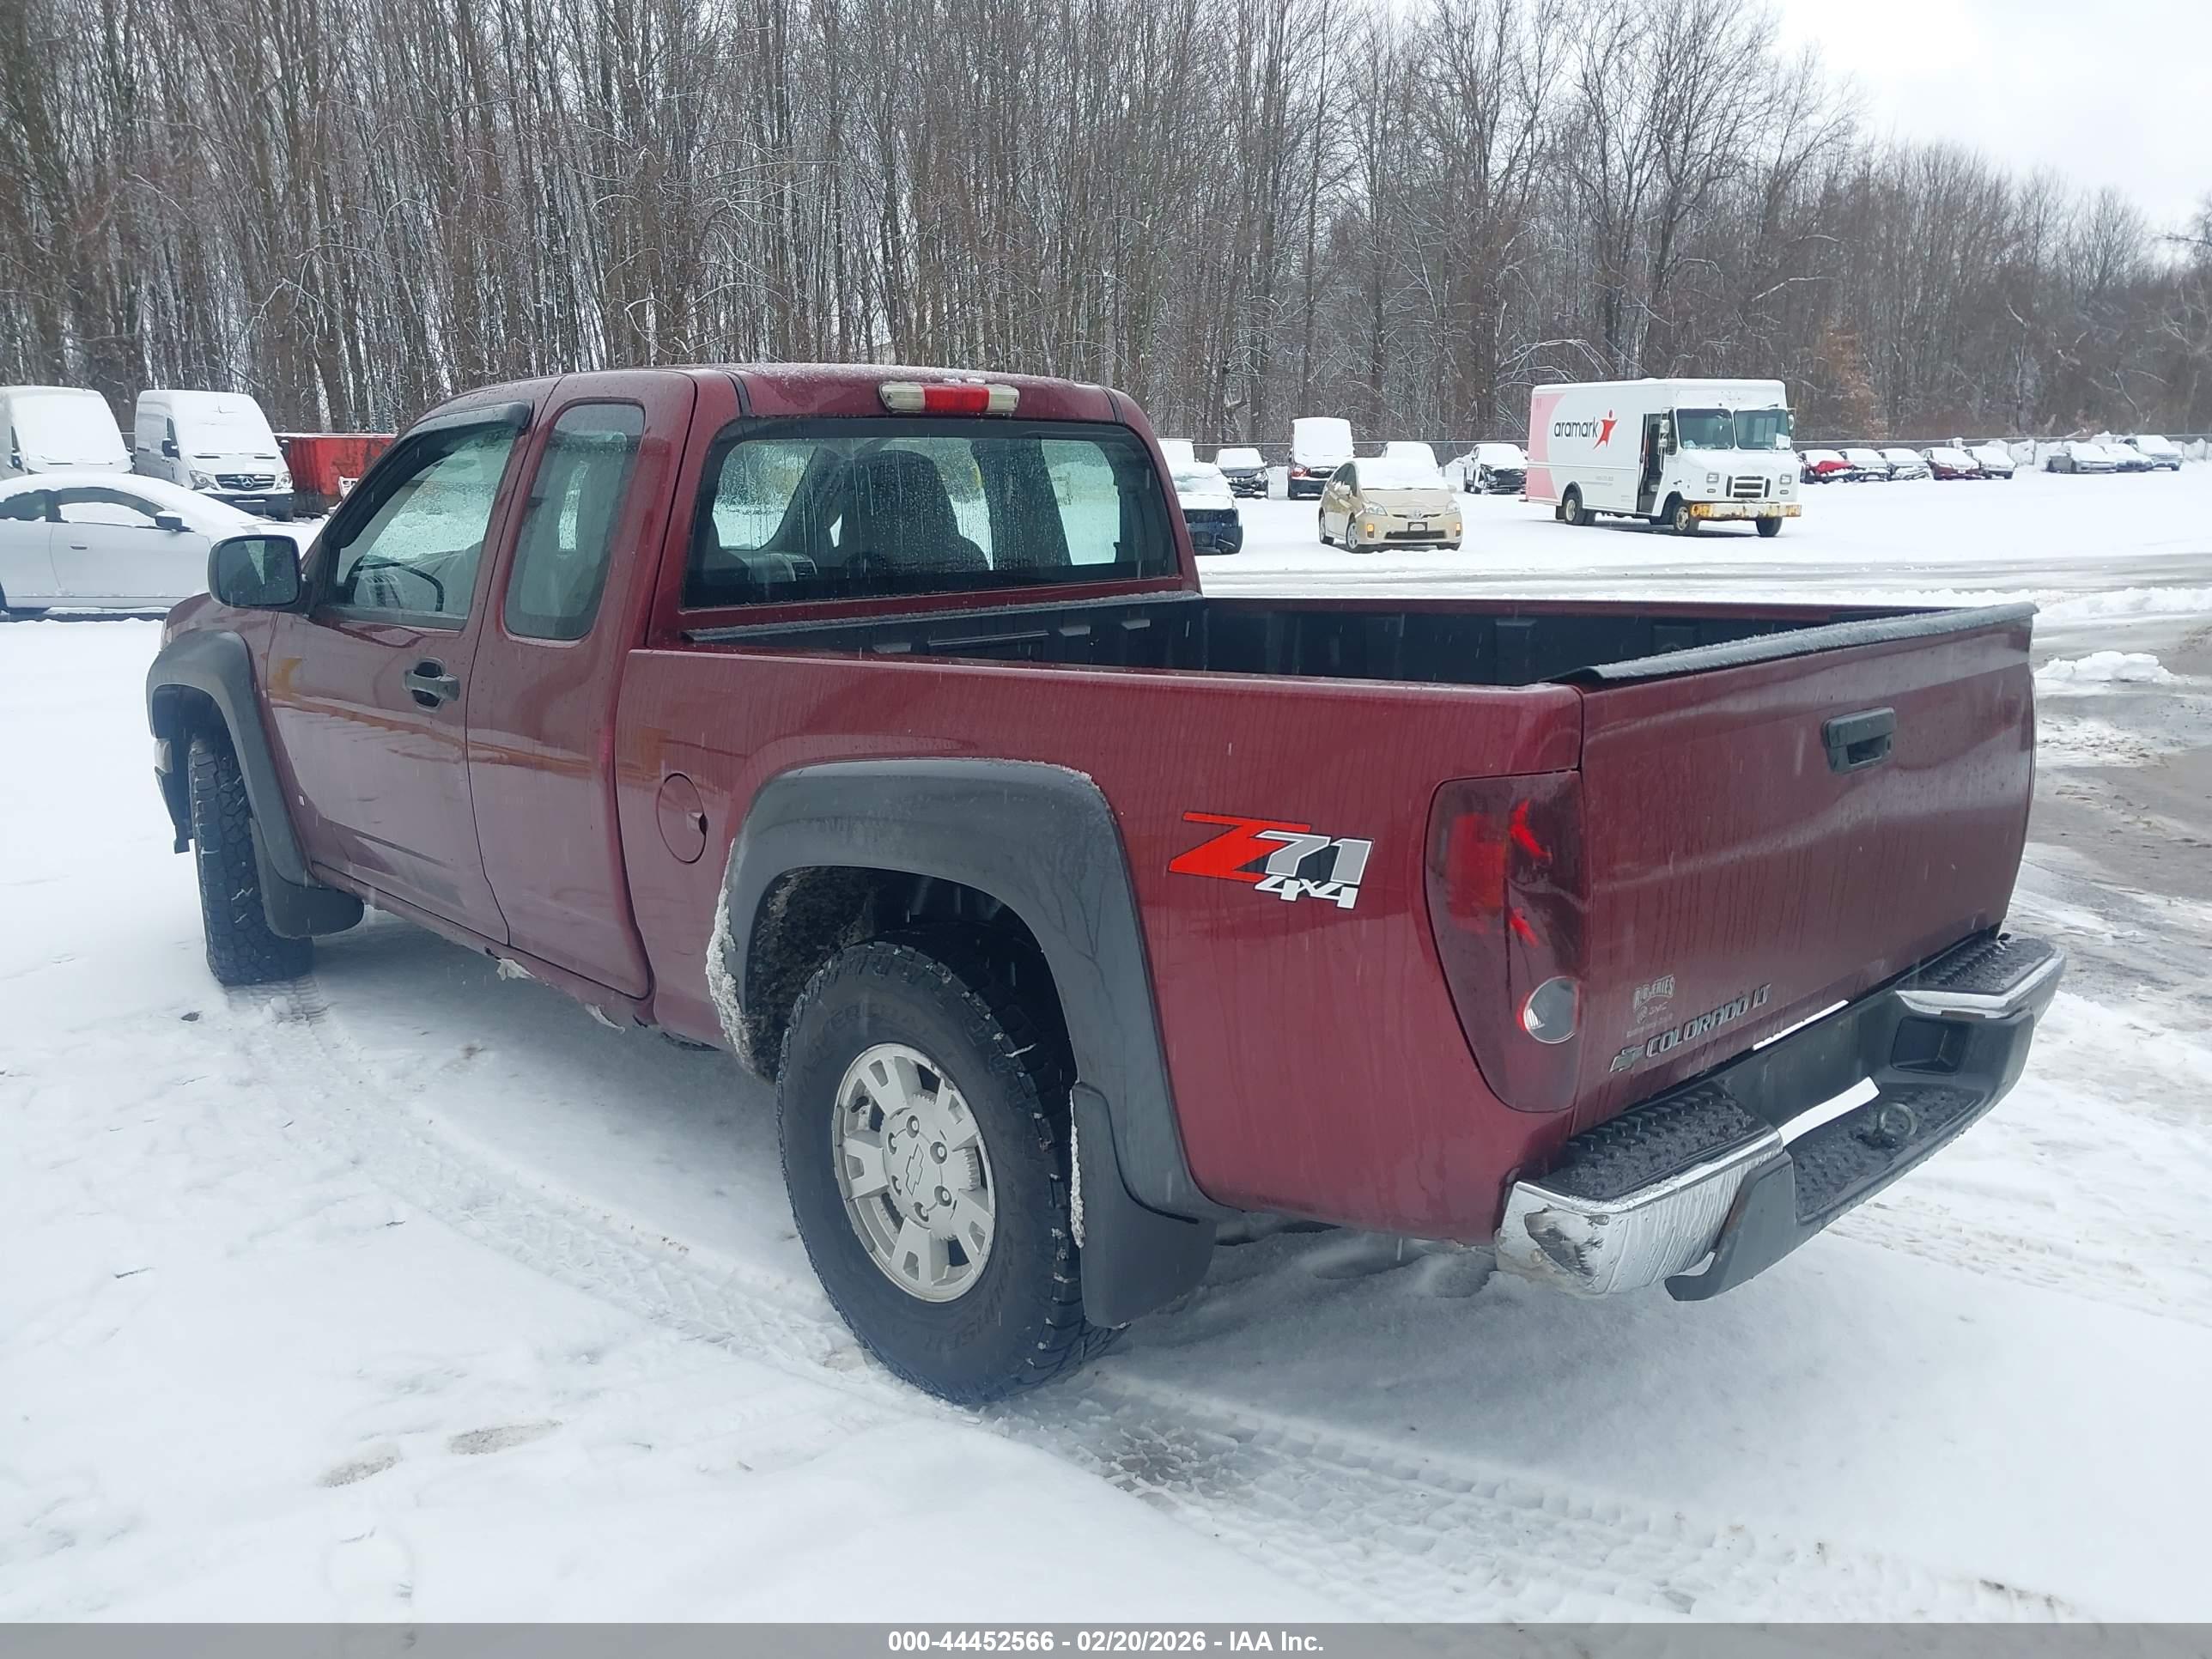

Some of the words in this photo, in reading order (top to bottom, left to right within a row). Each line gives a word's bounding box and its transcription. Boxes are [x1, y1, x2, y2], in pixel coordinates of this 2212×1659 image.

[1553, 416, 1599, 438] aramark
[1168, 811, 1374, 886] Z71
[1644, 994, 1750, 1059] COLORADO
[1752, 983, 1771, 1008] LT
